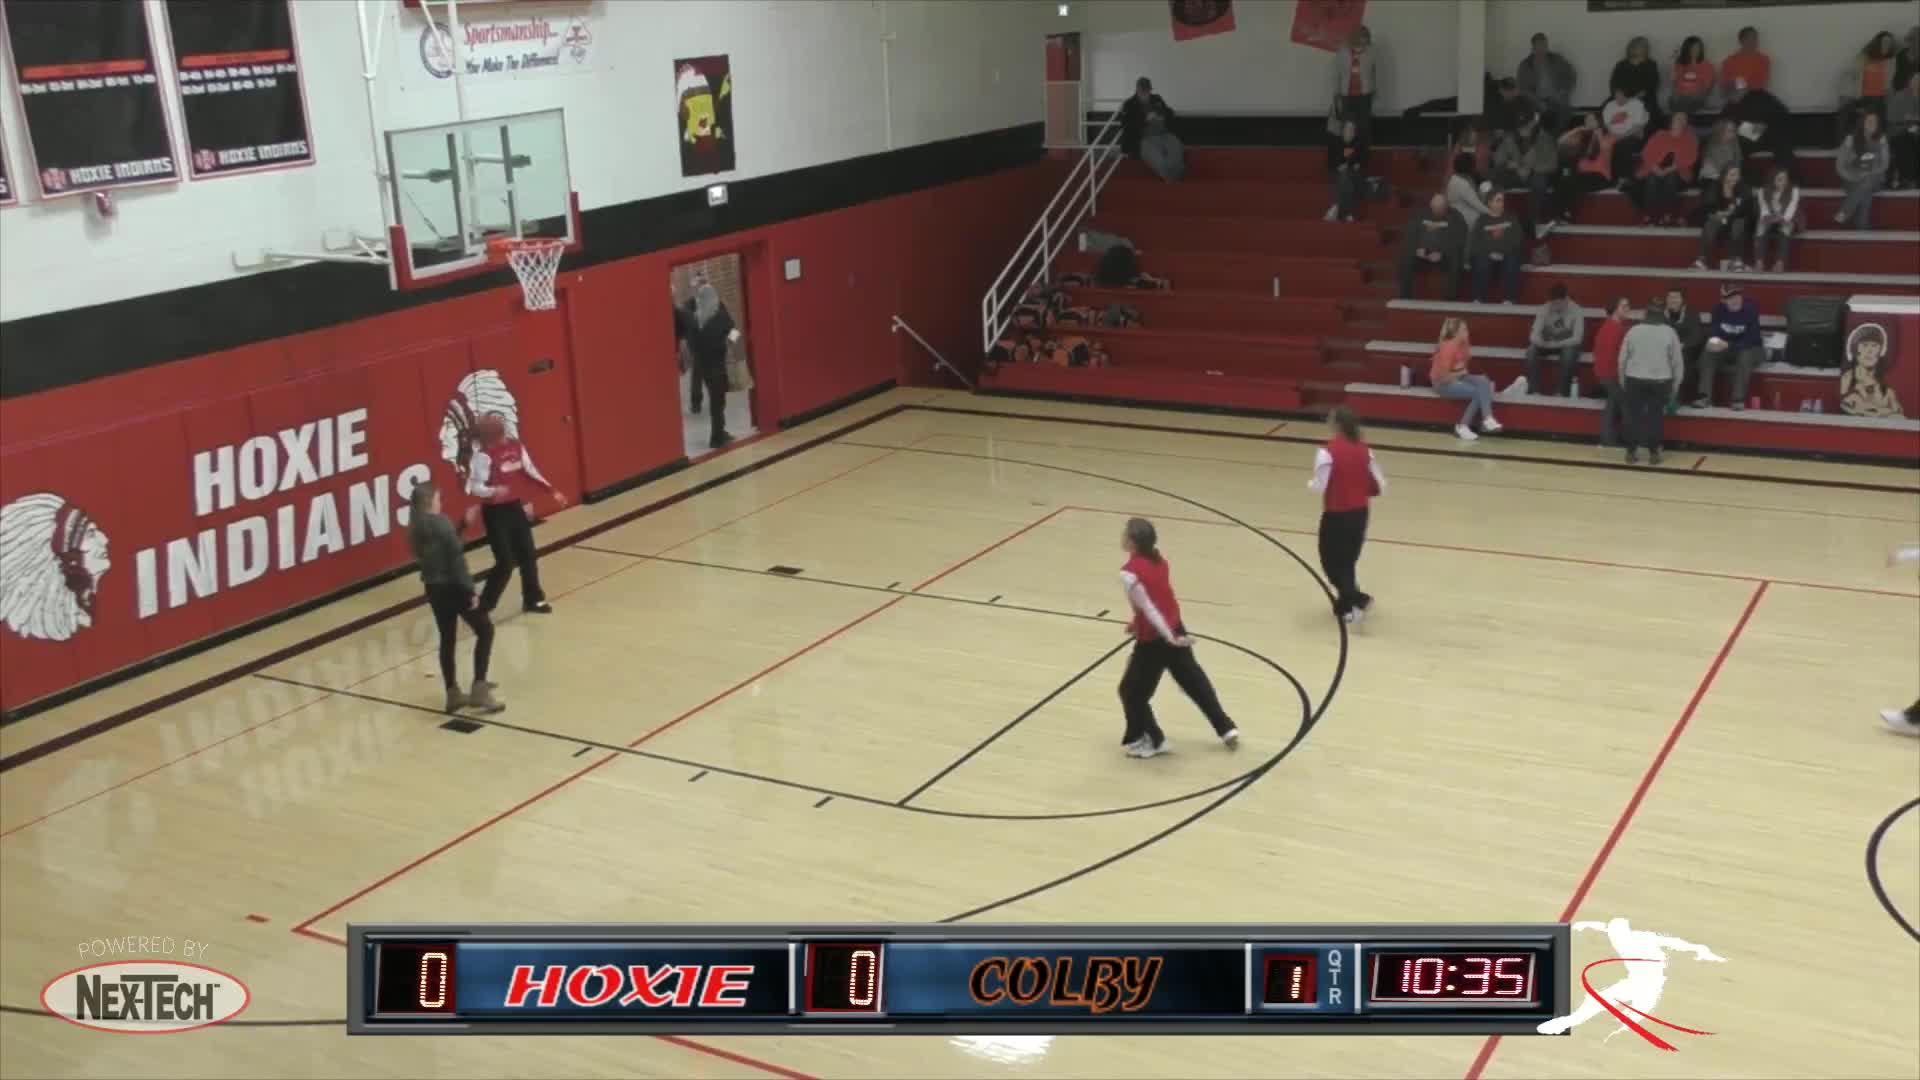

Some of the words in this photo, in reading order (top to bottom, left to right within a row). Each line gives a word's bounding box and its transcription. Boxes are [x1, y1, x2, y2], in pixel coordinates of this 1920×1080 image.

[483, 55, 504, 72] Make
[507, 55, 520, 70] The
[216, 147, 255, 164] HOXIE
[257, 141, 306, 158] INDIANS
[70, 166, 112, 184] HOXIE
[115, 158, 173, 177] INDIANS
[193, 407, 368, 516] HOXIE
[135, 463, 432, 618] INDIANS
